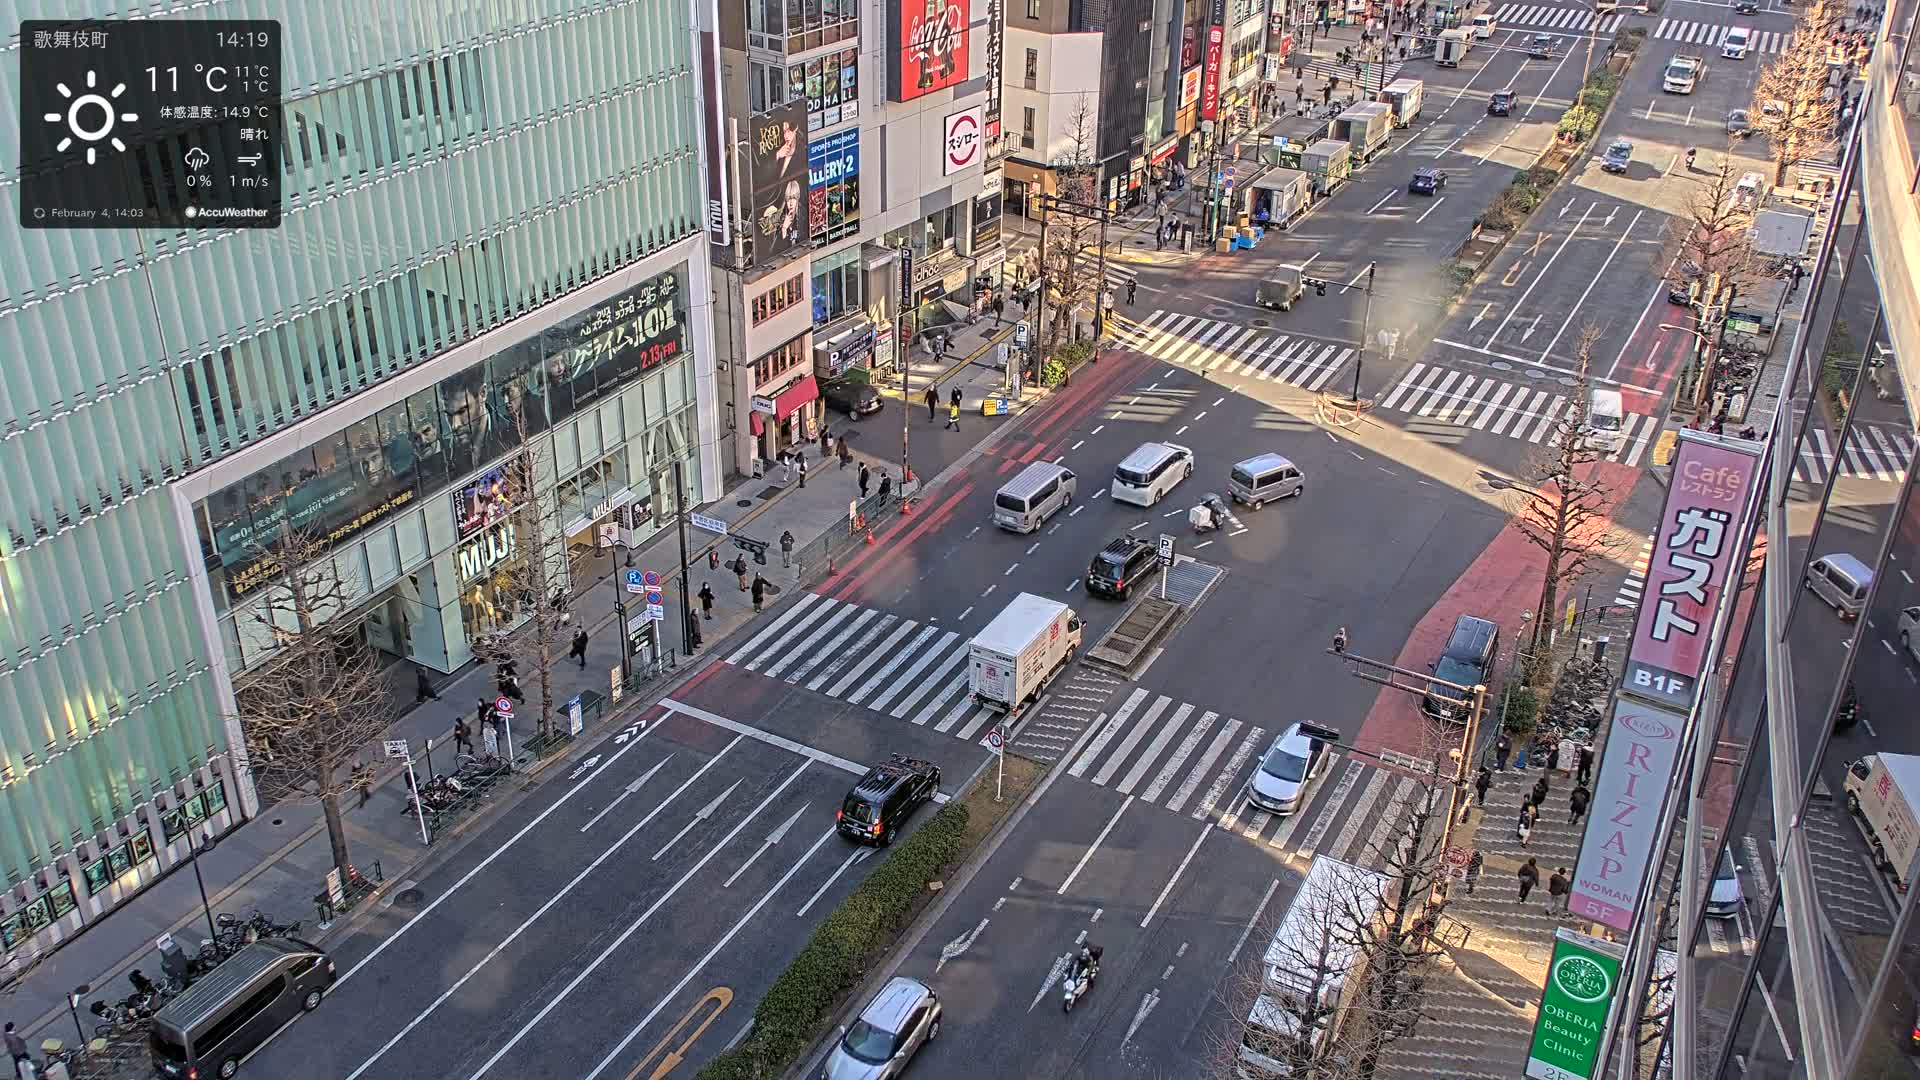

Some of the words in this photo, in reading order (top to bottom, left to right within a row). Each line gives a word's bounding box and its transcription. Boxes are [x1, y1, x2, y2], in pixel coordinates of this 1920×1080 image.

[1205, 45, 1220, 110] バーガーキング
[824, 87, 852, 106] HALL
[811, 142, 831, 153] SPORTS
[832, 139, 842, 148] PRO
[842, 133, 856, 143] SHOP
[948, 133, 979, 151] スシロー
[710, 200, 723, 233] MUJI
[829, 223, 857, 240] BASKETBALL
[618, 295, 634, 308] マーク
[641, 286, 656, 298] バリー
[596, 306, 612, 320] クリス
[615, 306, 635, 320] ラファロ
[1018, 326, 1025, 334] P
[640, 344, 660, 369] 2.13
[663, 339, 676, 358] FRI
[831, 351, 839, 367] P
[1683, 460, 1742, 489] Café
[1679, 481, 1736, 502] レストラン
[592, 497, 615, 519] MUJI
[459, 523, 518, 581] MUJI
[1161, 540, 1169, 548] P
[1651, 507, 1732, 642] ガスト
[1633, 669, 1684, 694] B1F
[1599, 742, 1652, 881] RIZAP
[1579, 879, 1633, 904] WOMAN
[1584, 902, 1616, 920] 5F
[1560, 969, 1601, 990] OBERIA
[1544, 1004, 1600, 1033] OBERIA
[1544, 1019, 1592, 1046] Beauty
[1543, 1038, 1584, 1062] Clinic
